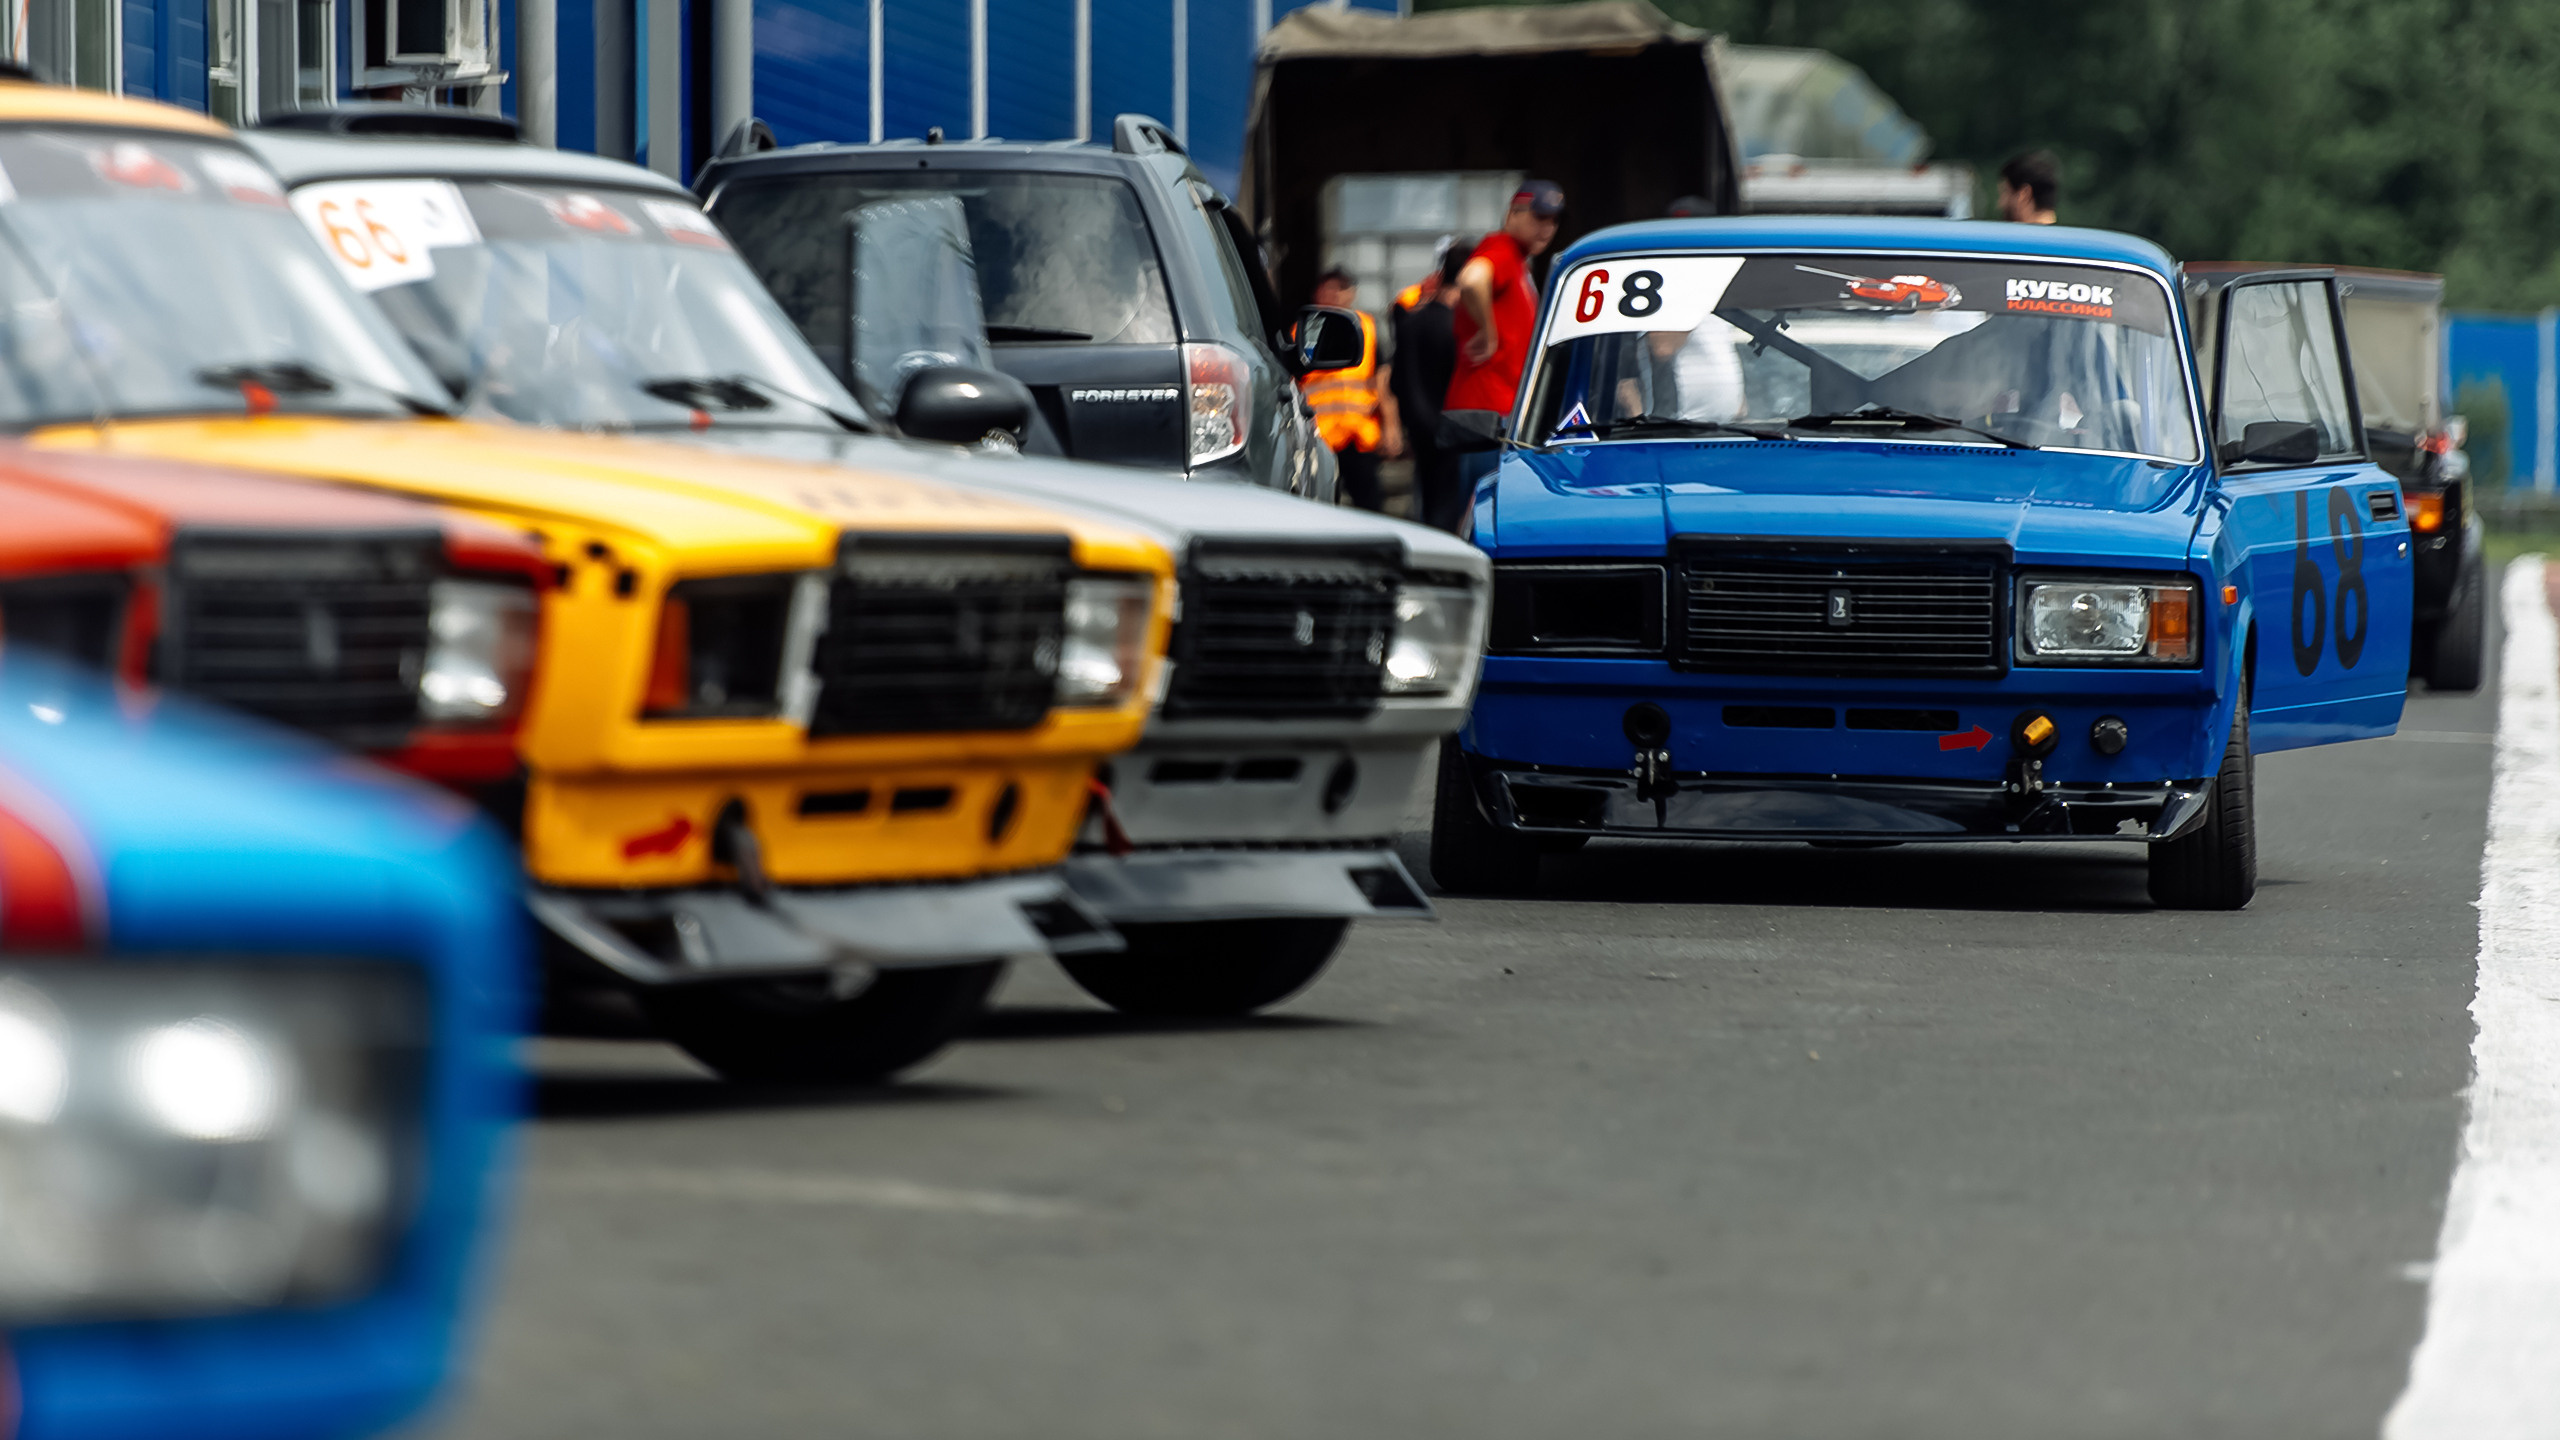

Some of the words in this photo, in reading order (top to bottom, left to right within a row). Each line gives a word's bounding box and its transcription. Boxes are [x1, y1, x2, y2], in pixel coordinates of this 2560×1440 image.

[317, 196, 410, 270] 66
[1575, 269, 1664, 323] 68
[2006, 278, 2114, 306] КУБОК
[2006, 298, 2113, 318] КЛАССИКИ
[1071, 388, 1179, 404] FORESTER
[2291, 485, 2369, 678] 68
